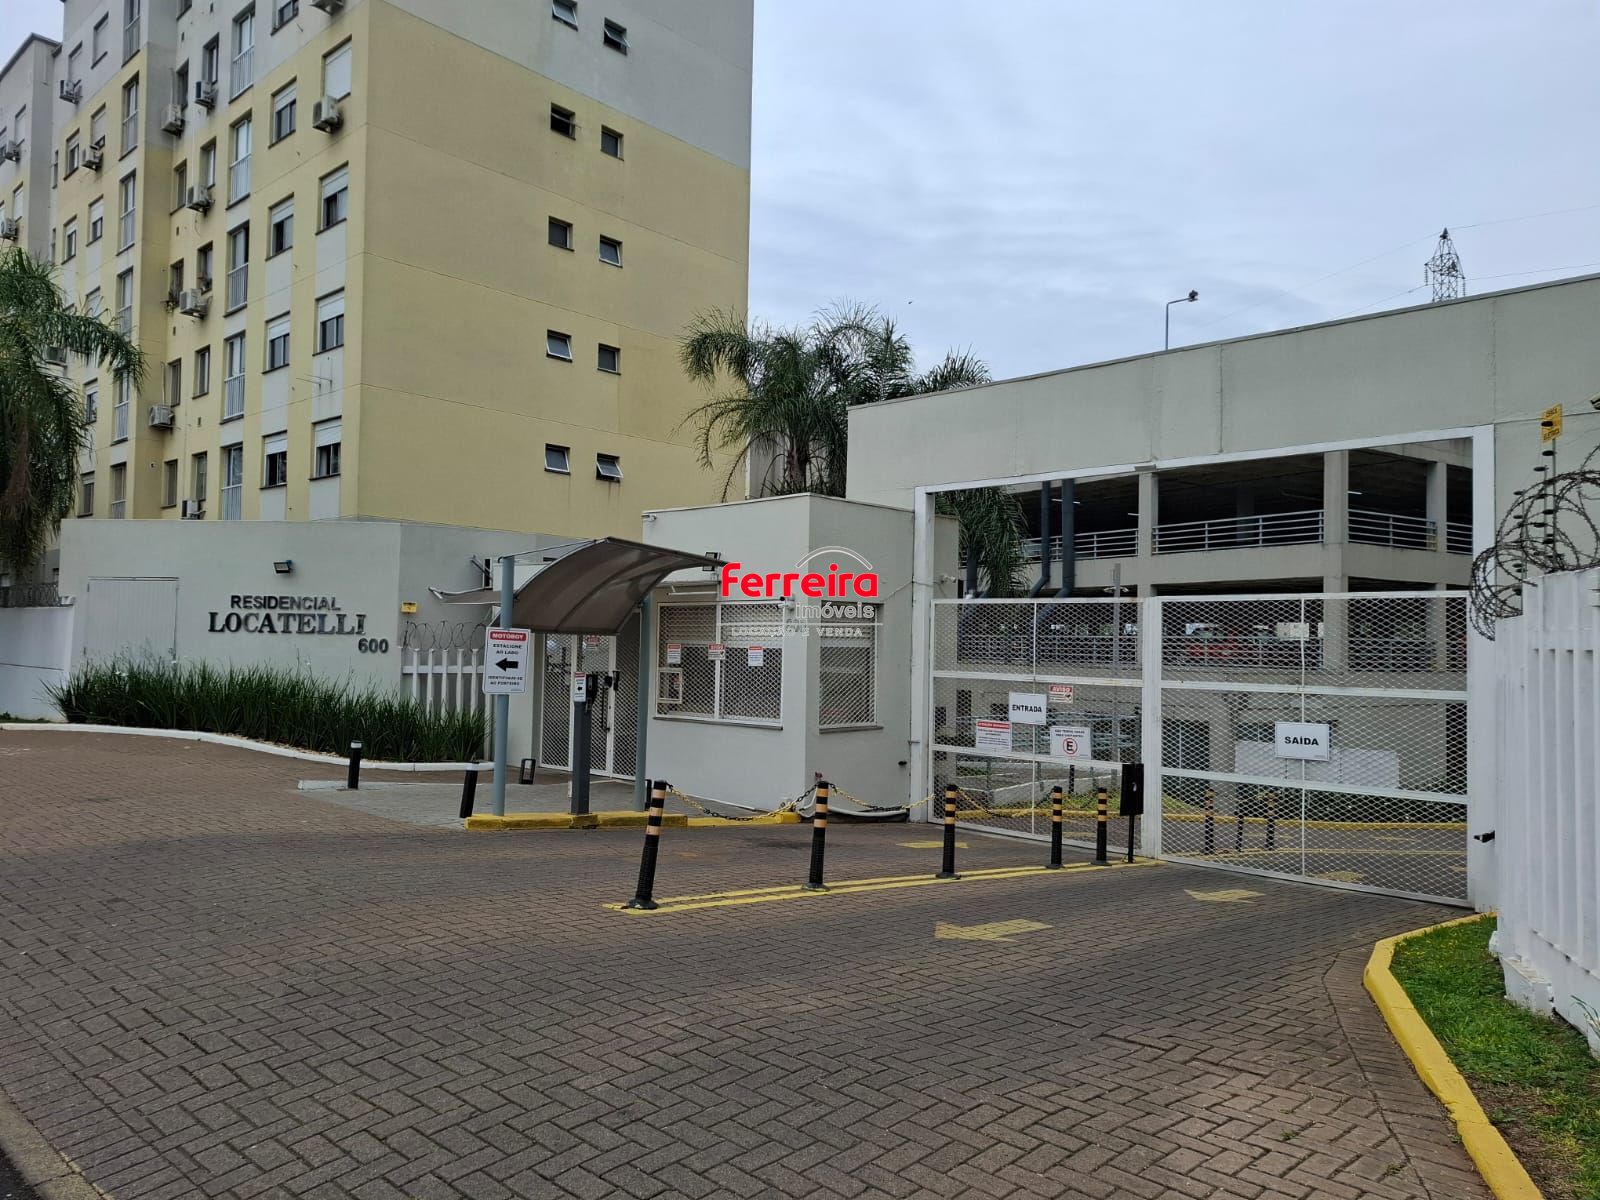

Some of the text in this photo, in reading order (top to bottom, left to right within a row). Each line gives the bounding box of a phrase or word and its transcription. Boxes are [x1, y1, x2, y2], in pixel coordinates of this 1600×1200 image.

[230, 595, 341, 611] RESIDENCIAL
[208, 612, 367, 635] LOCATELLI
[358, 638, 389, 654] 600
[1012, 704, 1042, 713] ENTRADA
[1066, 741, 1074, 751] E
[1285, 736, 1319, 745] SAÍDA
